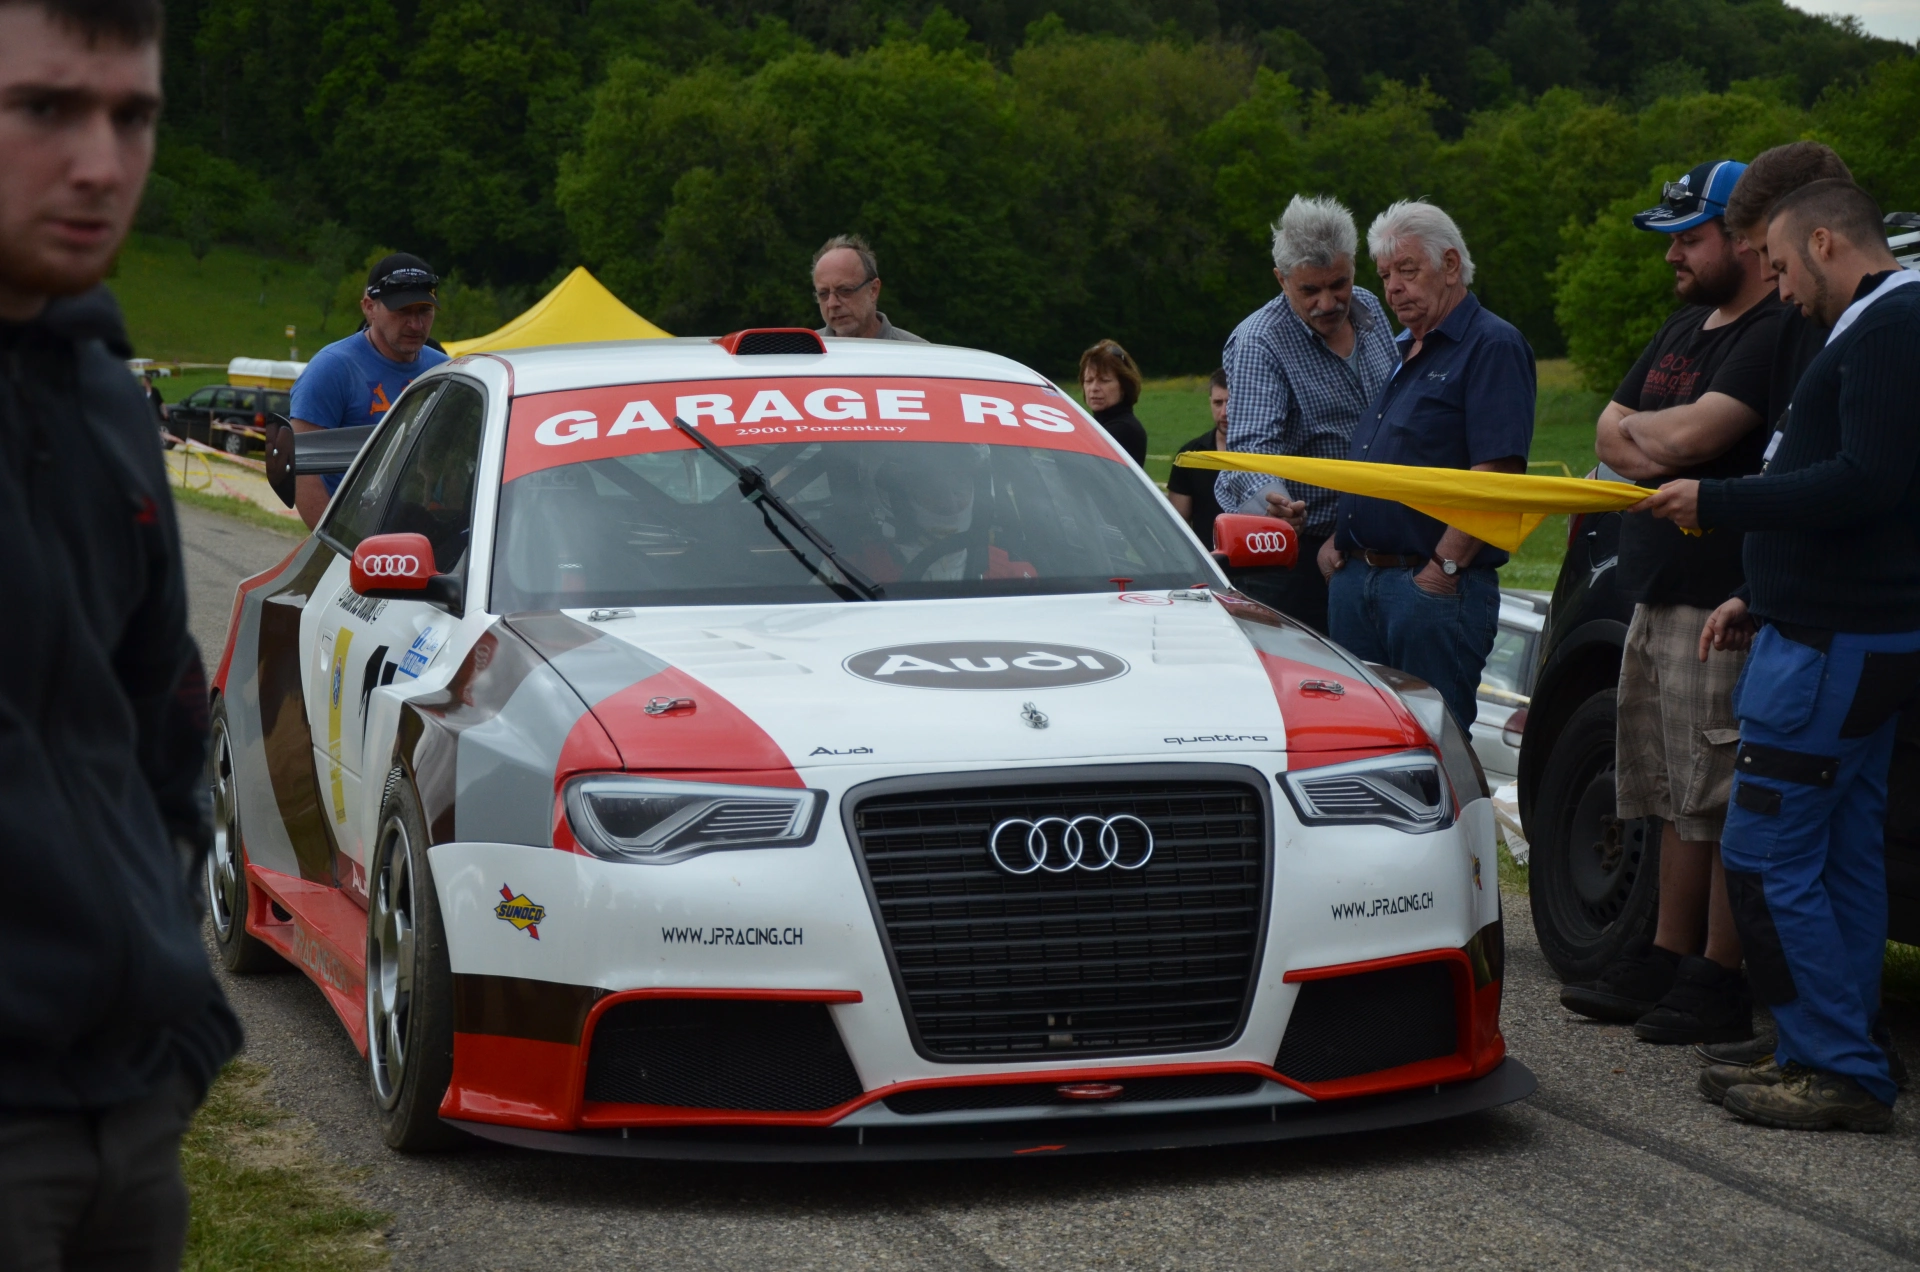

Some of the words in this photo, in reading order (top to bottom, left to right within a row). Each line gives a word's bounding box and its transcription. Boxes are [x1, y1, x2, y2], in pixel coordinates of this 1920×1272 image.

[534, 388, 930, 446] GARAGE
[959, 393, 1075, 433] RS
[735, 426, 787, 436] 2900
[794, 425, 907, 434] Porrentruy
[874, 651, 1105, 676] Audi
[1163, 734, 1268, 745] quattro
[808, 746, 873, 756] Audi
[499, 904, 543, 921] SUNOCO
[1331, 891, 1434, 921] WWW.JPRACING.CH
[661, 927, 803, 945] WWW.JPRACING.CH
